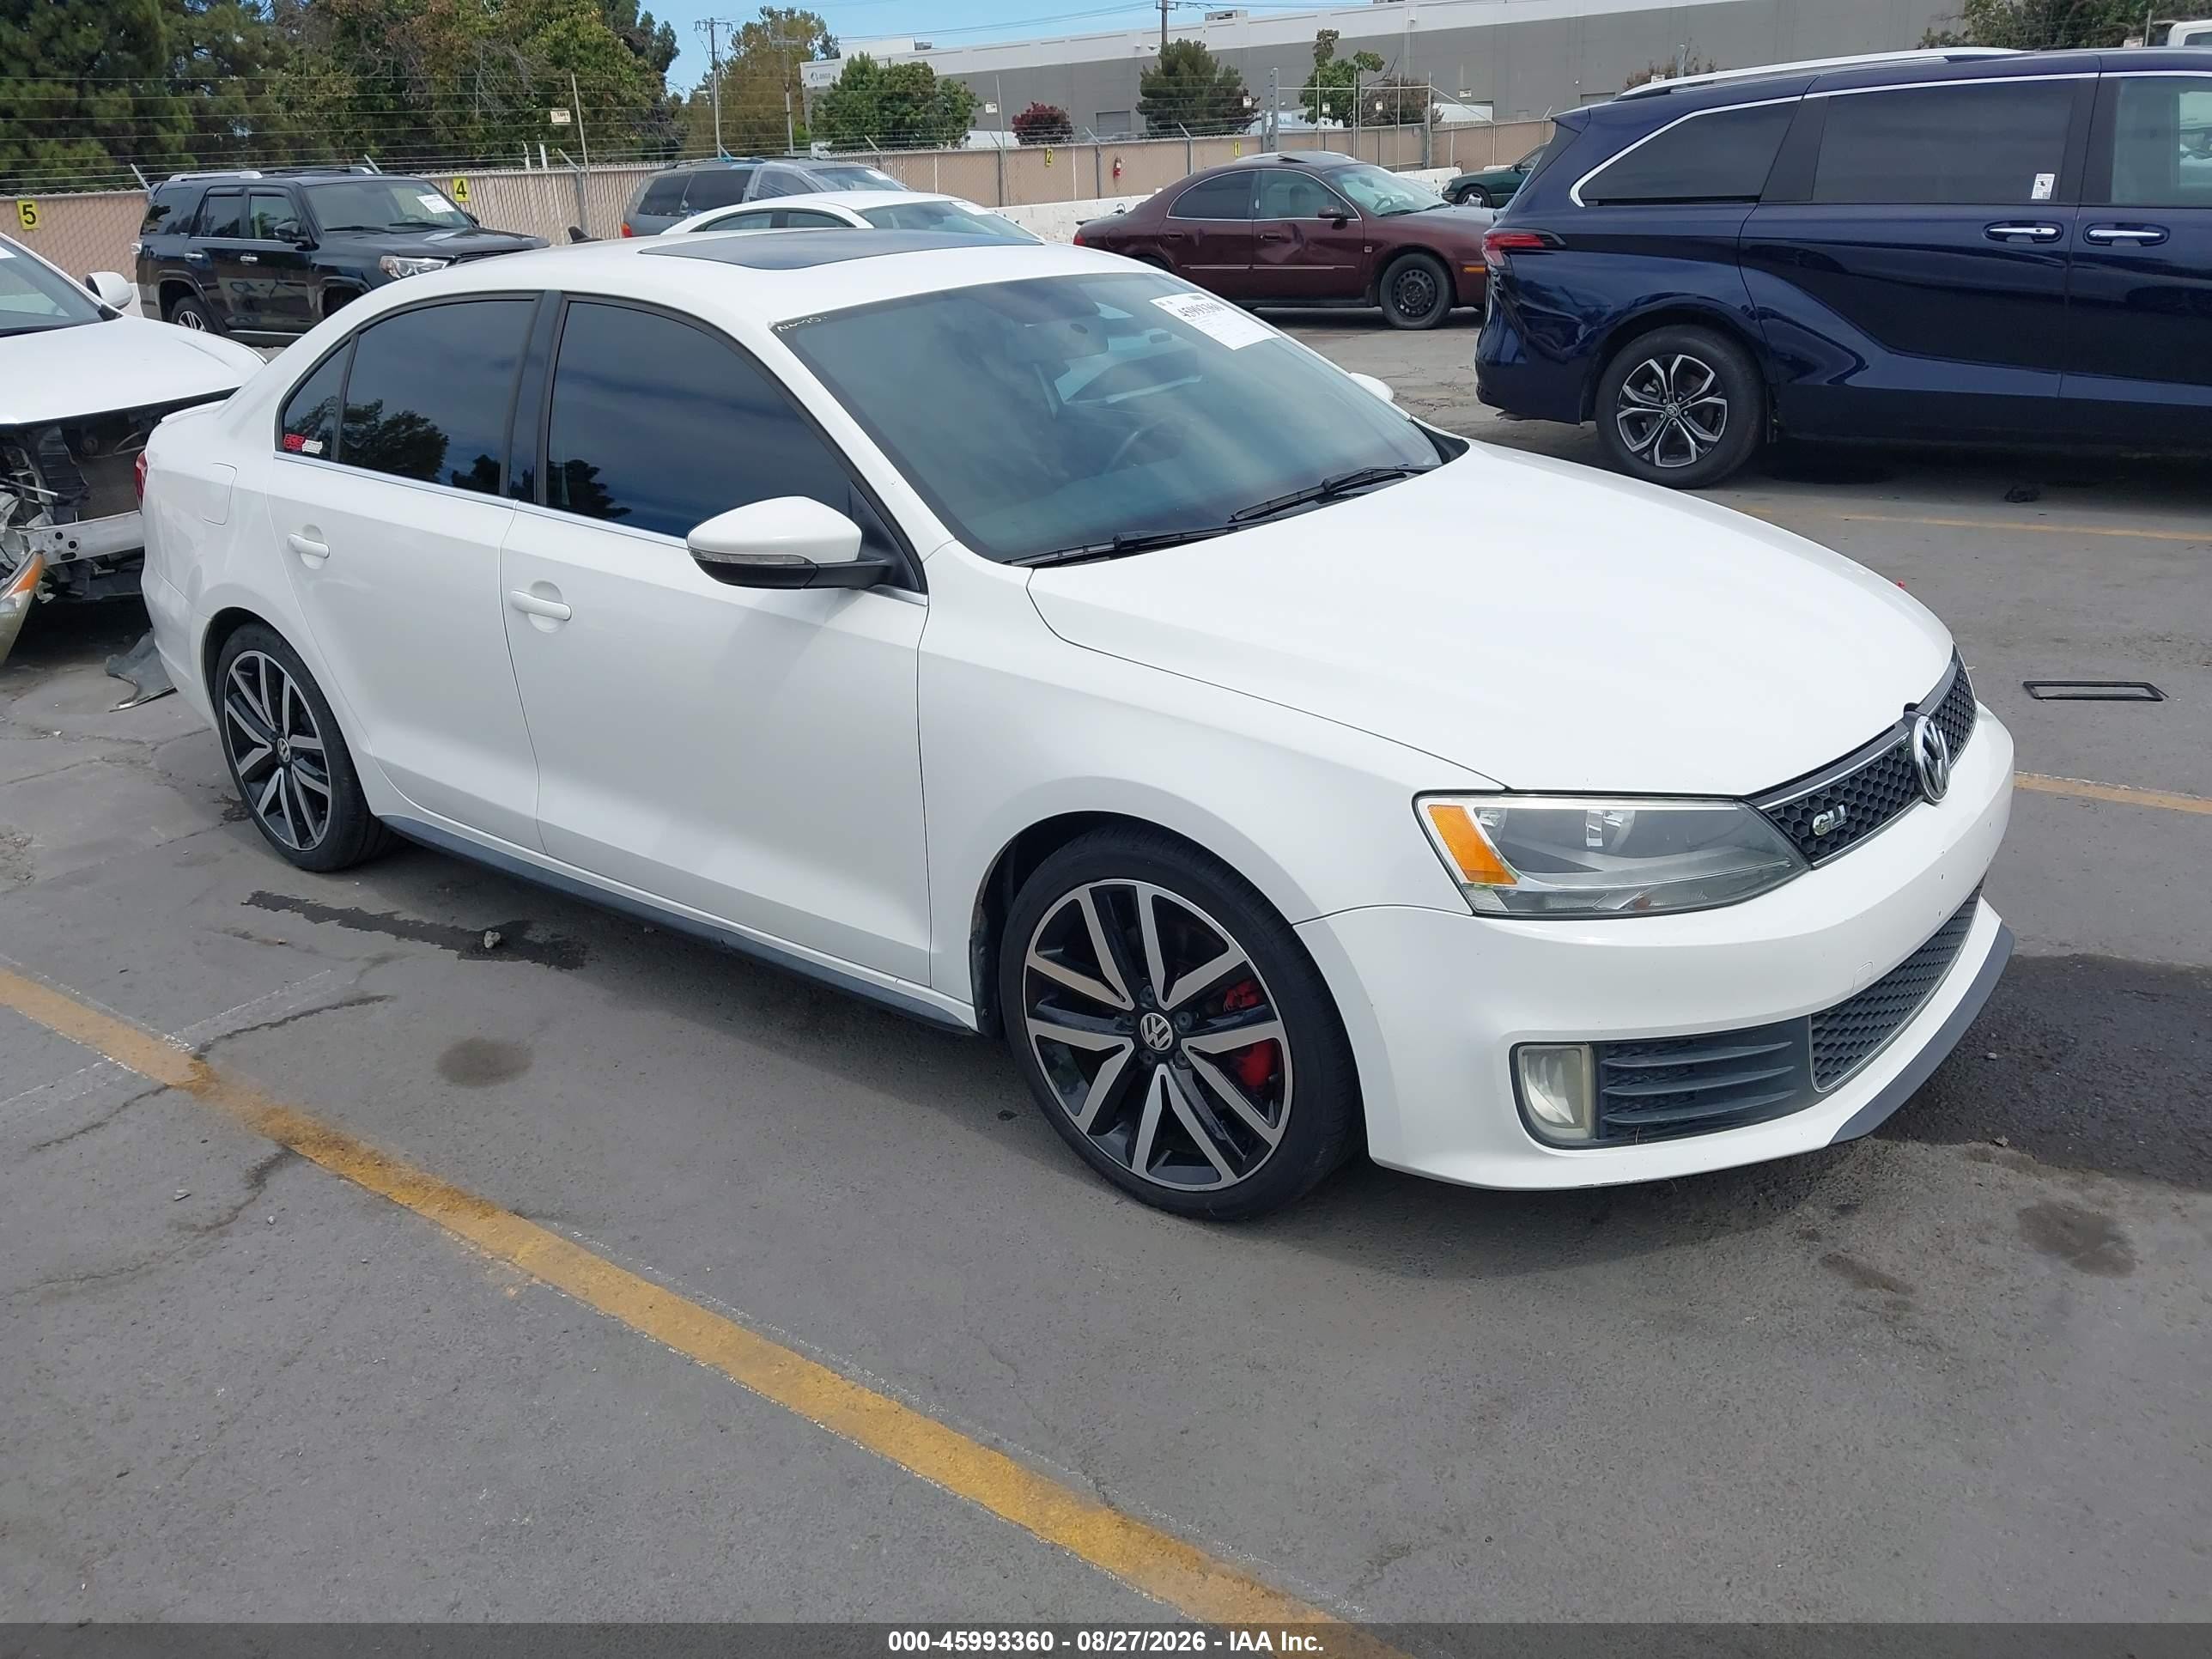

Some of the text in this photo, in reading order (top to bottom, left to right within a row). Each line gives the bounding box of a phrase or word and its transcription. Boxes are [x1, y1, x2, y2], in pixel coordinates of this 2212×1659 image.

[1047, 150, 1053, 164] 2
[456, 180, 467, 198] 4
[22, 204, 36, 225] 5
[1812, 805, 1847, 836] GLI
